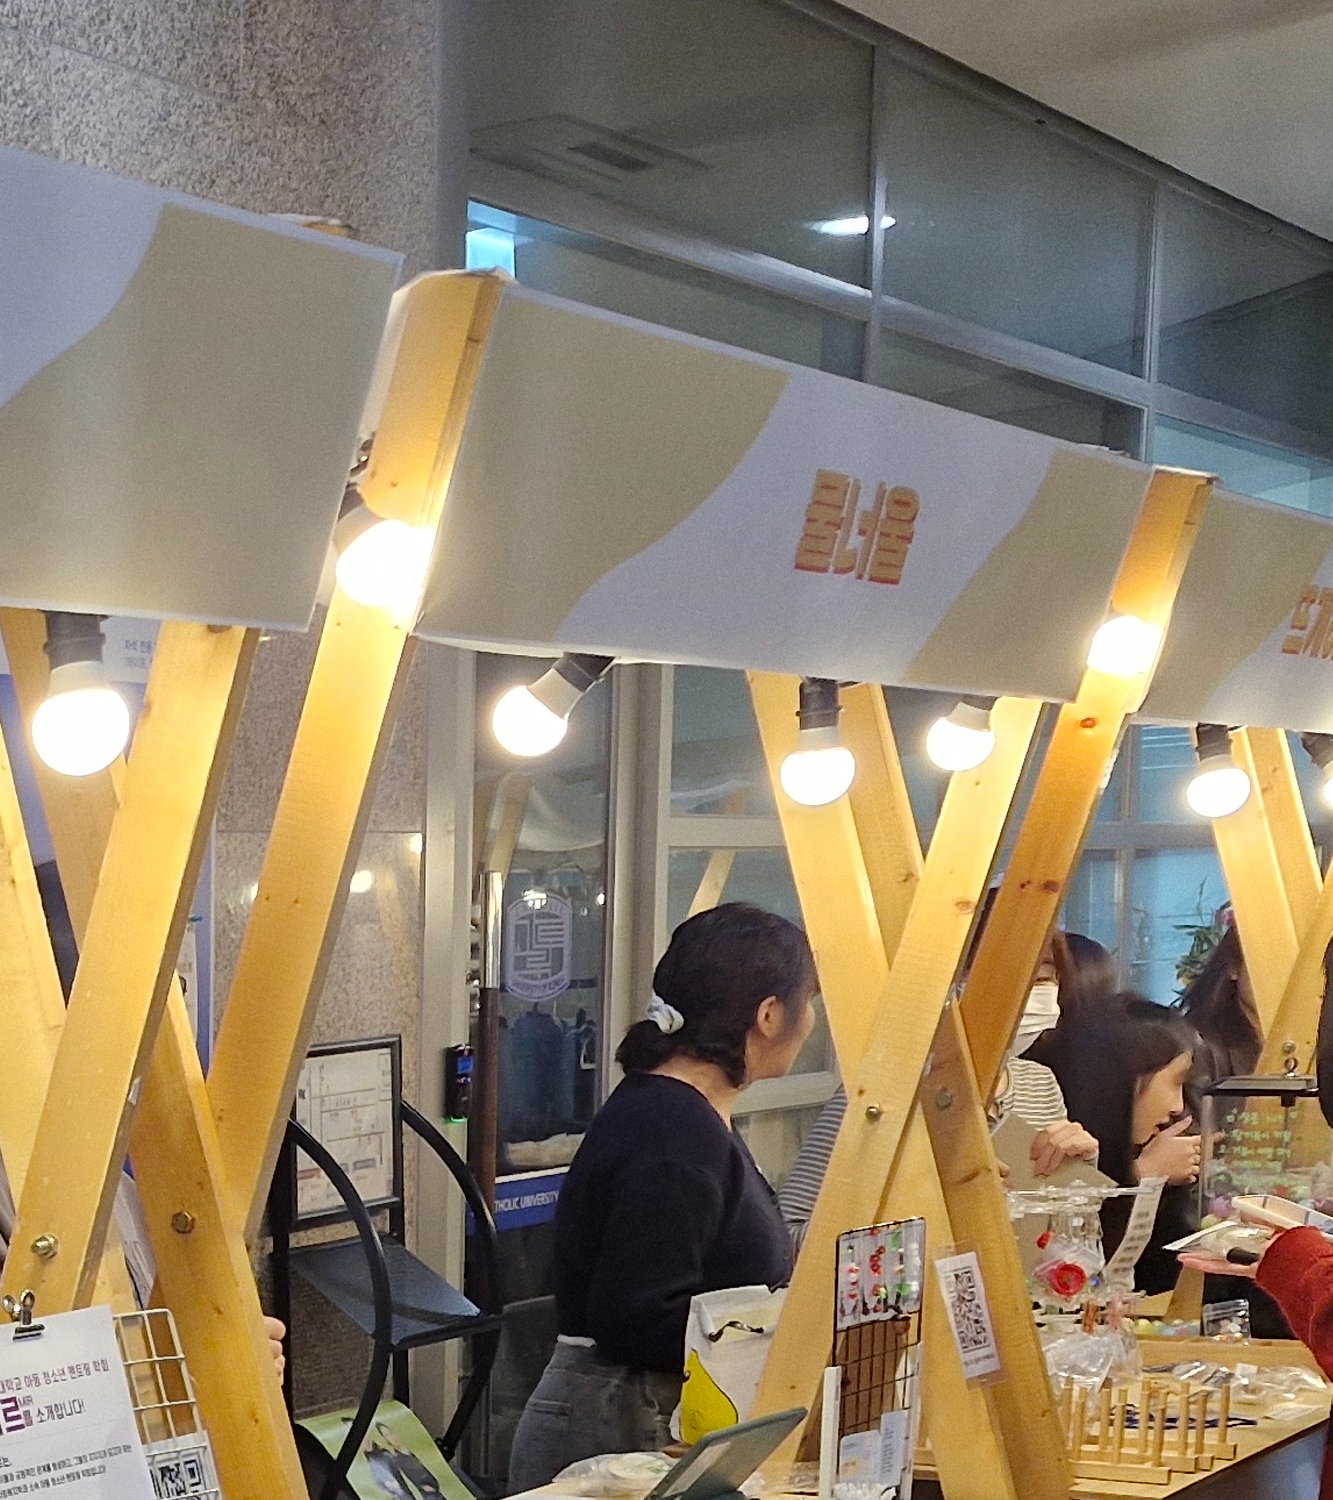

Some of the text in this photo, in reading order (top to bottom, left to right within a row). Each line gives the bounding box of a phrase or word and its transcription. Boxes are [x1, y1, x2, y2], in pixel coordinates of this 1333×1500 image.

[520, 1189, 560, 1209] UNIVERSITY
[23, 1372, 41, 1388] 아동
[41, 1367, 67, 1385] 청소년
[66, 1361, 91, 1379] 멘토링
[91, 1357, 109, 1373] 학회
